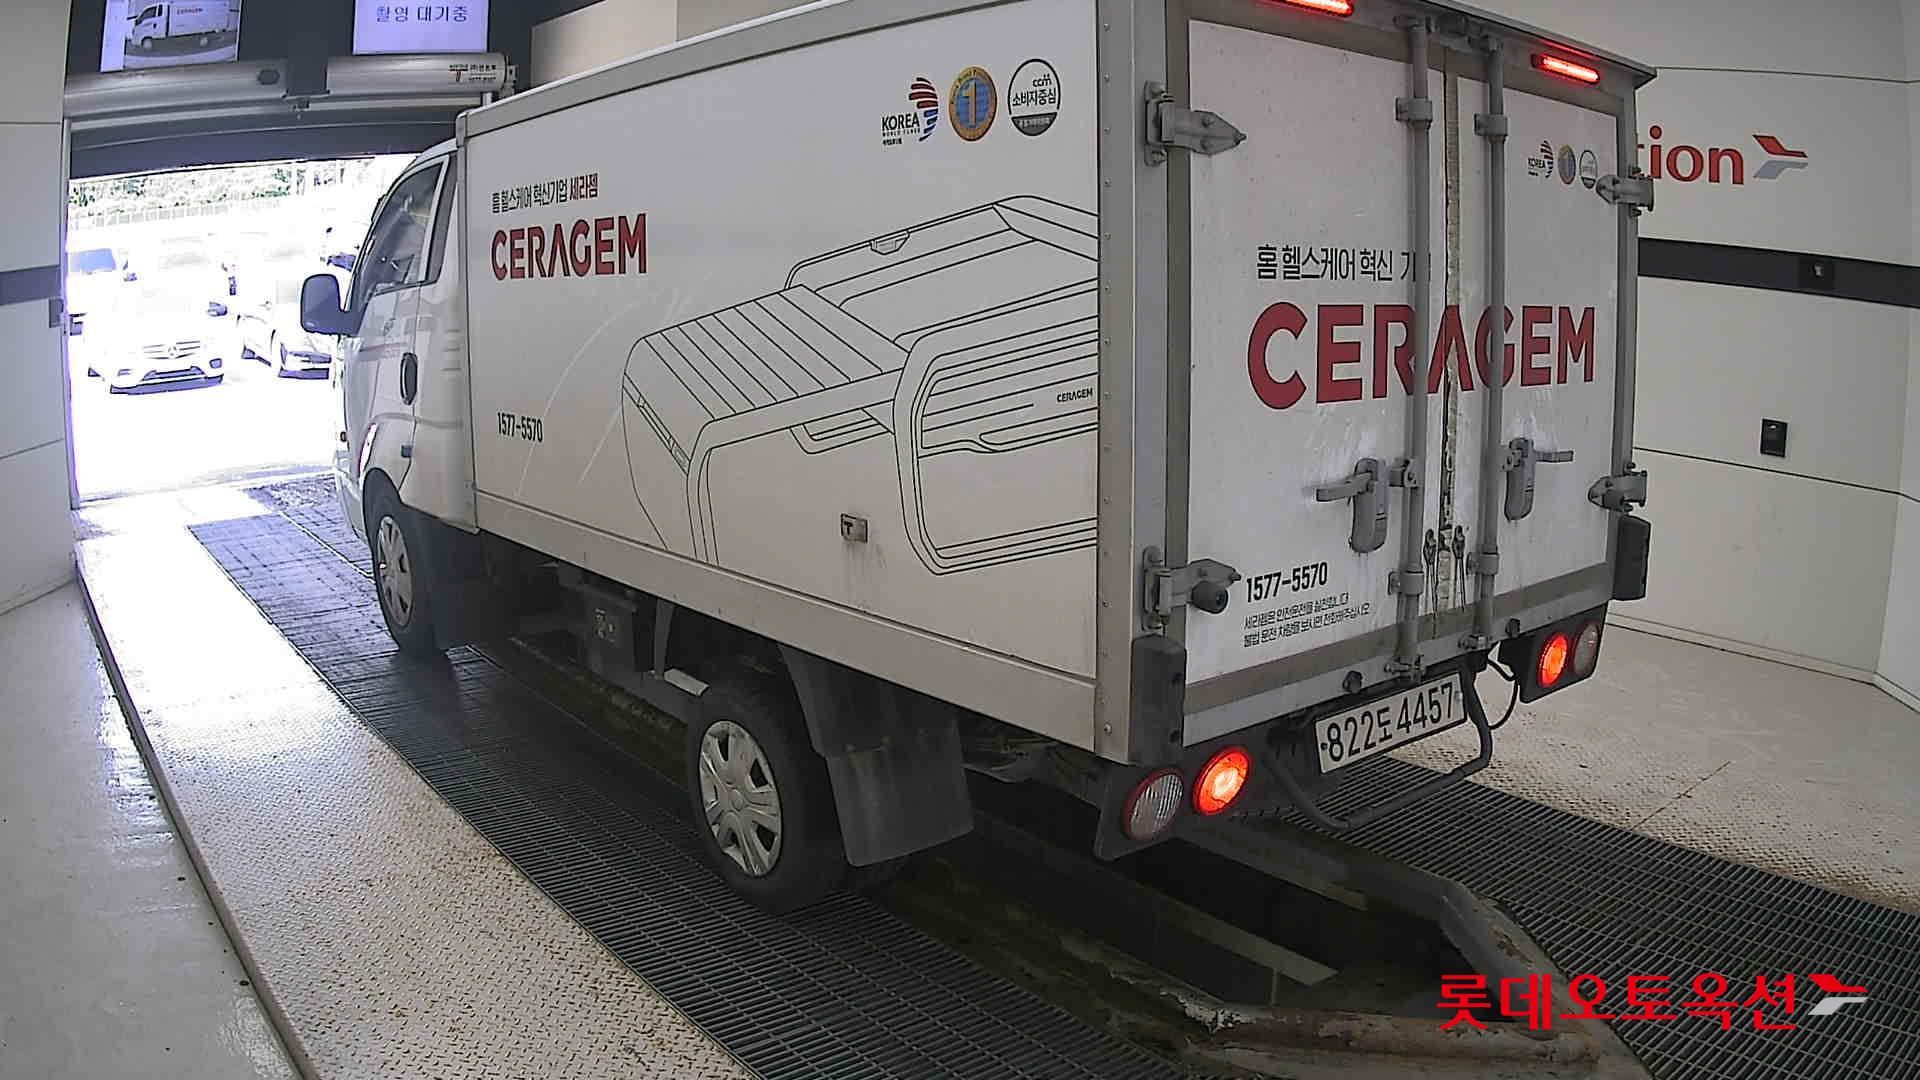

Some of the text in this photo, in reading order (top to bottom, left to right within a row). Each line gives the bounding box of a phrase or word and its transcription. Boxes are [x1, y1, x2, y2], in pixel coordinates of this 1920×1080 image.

[1012, 88, 1056, 107] 소비자중심
[882, 112, 920, 131] KOREA
[1637, 125, 1744, 185] ion
[533, 178, 568, 206] 혁신기업
[569, 172, 598, 201] 세라젬
[491, 213, 647, 281] CERAGEM
[1359, 248, 1393, 281] 혁신
[1248, 302, 1595, 410] CERAGEM
[498, 412, 543, 443] 1577-5570
[1246, 562, 1328, 603] 1577-5570
[1327, 682, 1453, 762] 822도 4457
